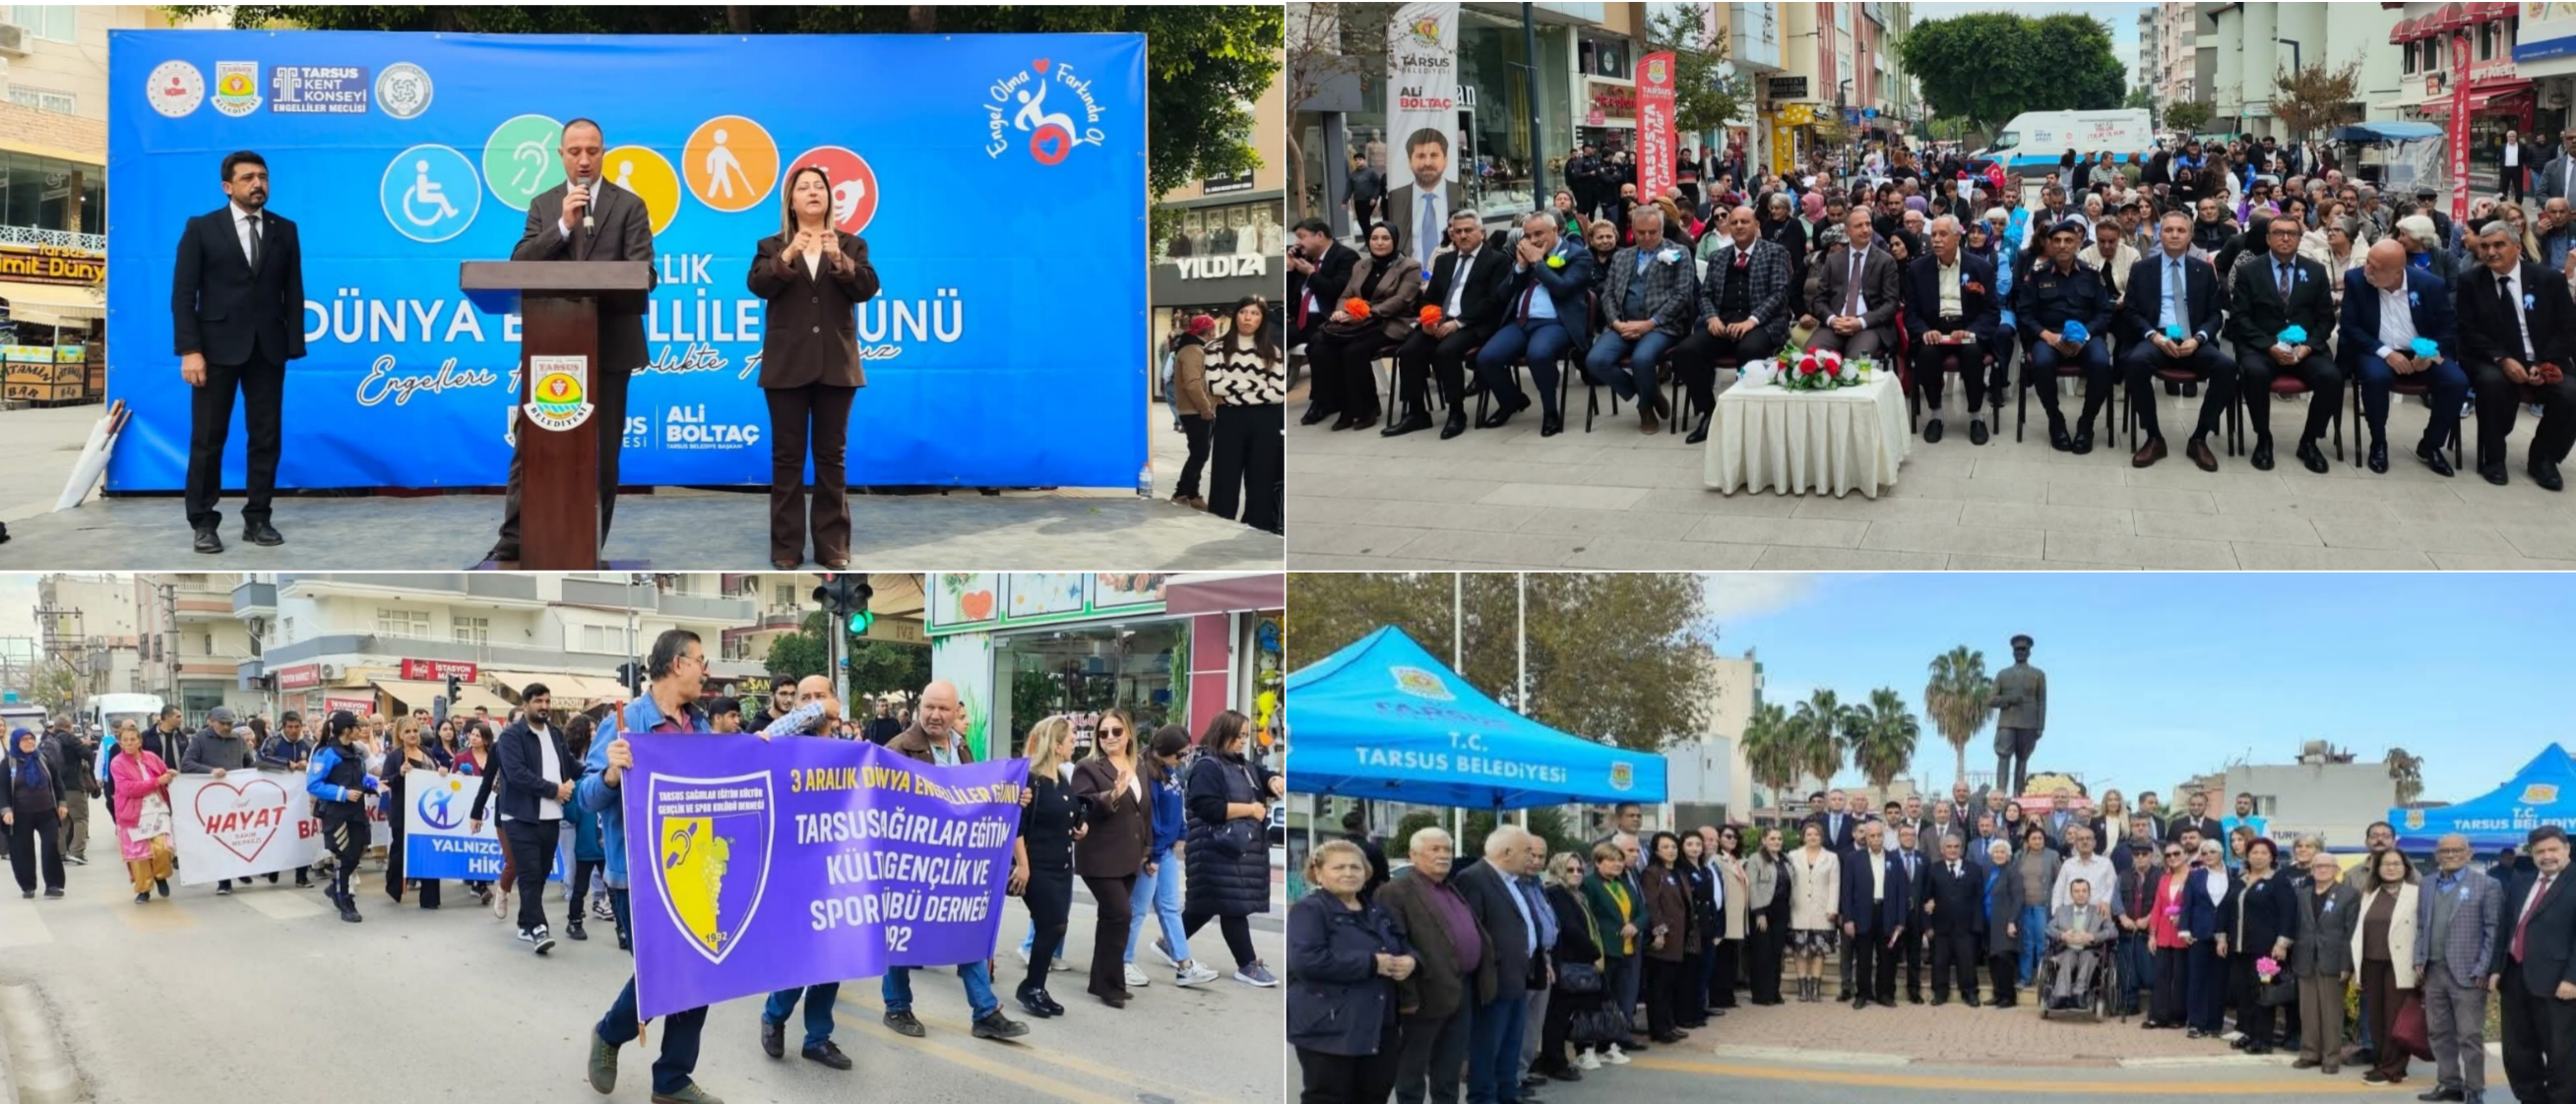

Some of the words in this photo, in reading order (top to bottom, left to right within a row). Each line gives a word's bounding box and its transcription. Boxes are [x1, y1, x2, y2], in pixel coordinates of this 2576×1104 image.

[1401, 56, 1450, 67] TARSUS
[301, 67, 358, 79] TARSUS
[304, 80, 343, 90] KENT
[990, 70, 1030, 101] Olma
[1056, 62, 1105, 123] Farkında
[1642, 86, 1672, 95] TARSUS
[304, 89, 367, 101] KONSEYİ
[273, 102, 327, 113] ENGELLİLER
[329, 102, 366, 113] MECLİSİ
[1400, 98, 1452, 110] BOLTAÇ
[983, 103, 1009, 158] Engel
[1654, 111, 1665, 134] Var
[1084, 127, 1104, 147] Ol
[1655, 137, 1670, 187] Gelecek
[538, 363, 580, 372] TARSUS
[356, 354, 496, 405] Engelleri
[666, 424, 760, 446] BOLTAÇ
[435, 662, 471, 674] İSTASYON
[1448, 731, 1489, 752] T.C.
[1355, 747, 1449, 771] TARSUS
[790, 768, 801, 792] 3
[805, 767, 857, 791] ARALIK
[659, 791, 684, 802] TARSUS
[695, 802, 712, 813] SPOR
[2513, 808, 2539, 819] T.C.
[206, 805, 286, 834] HAYAT
[2454, 819, 2510, 829] TARSUS
[974, 859, 991, 885] VE
[810, 893, 881, 931] SPOR
[705, 932, 727, 943] 1992
